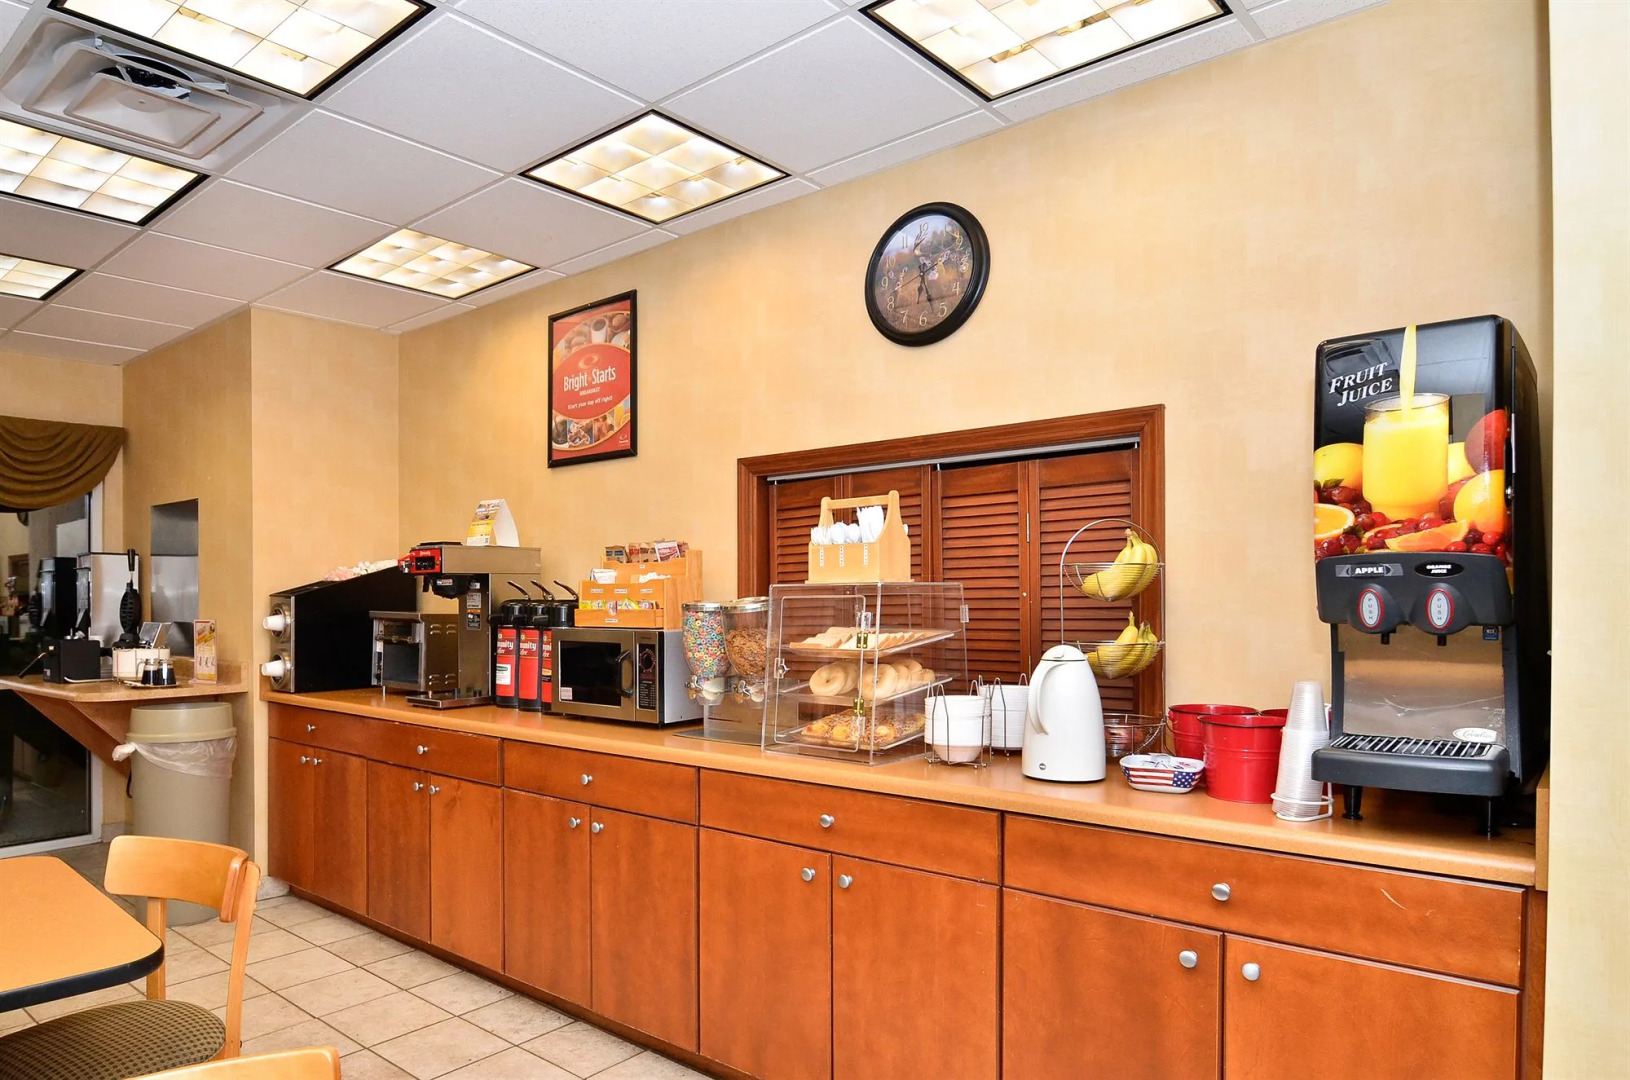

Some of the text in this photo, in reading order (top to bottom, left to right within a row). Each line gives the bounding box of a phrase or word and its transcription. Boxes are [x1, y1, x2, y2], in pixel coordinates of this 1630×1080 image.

[881, 276, 888, 291] 9
[952, 281, 960, 296] 4
[886, 296, 895, 311] 8
[938, 302, 947, 317] 5
[901, 310, 909, 324] 7
[919, 311, 928, 326] 6
[563, 365, 616, 392] Bright Starts
[1328, 362, 1388, 394] FRUIT
[1337, 378, 1393, 407] JUICE
[1354, 566, 1384, 575] APPLE
